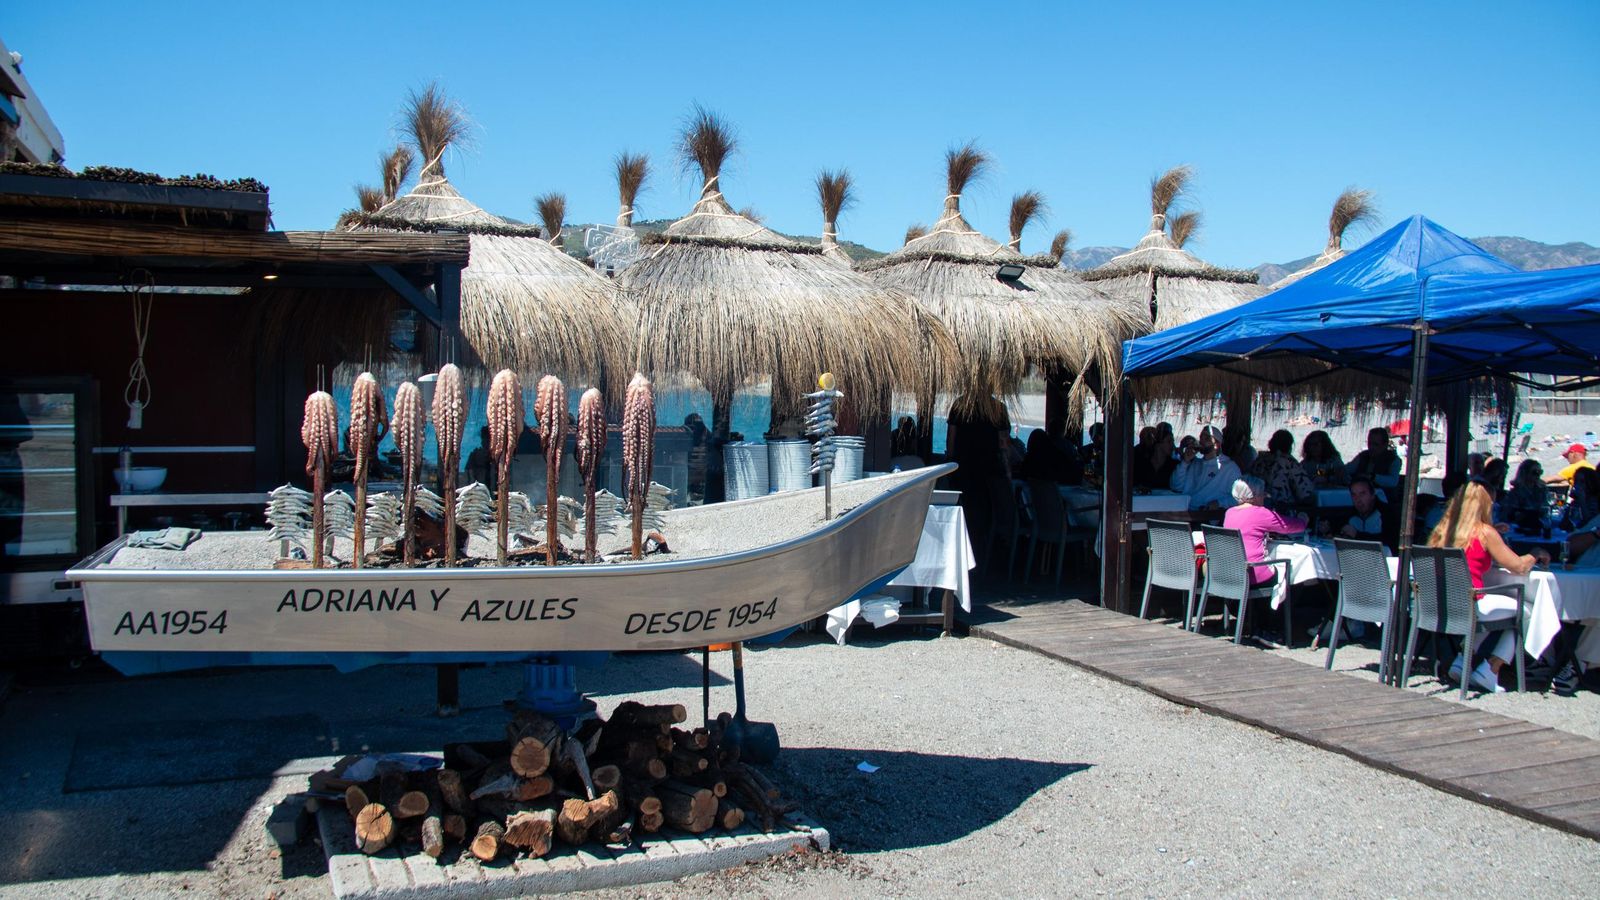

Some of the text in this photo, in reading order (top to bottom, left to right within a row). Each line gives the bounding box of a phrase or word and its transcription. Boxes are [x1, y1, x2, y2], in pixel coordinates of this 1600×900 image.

[277, 587, 579, 622] ADRIANA Y AZULES
[623, 597, 778, 635] DESDE 1954
[113, 609, 228, 636] AA1954
